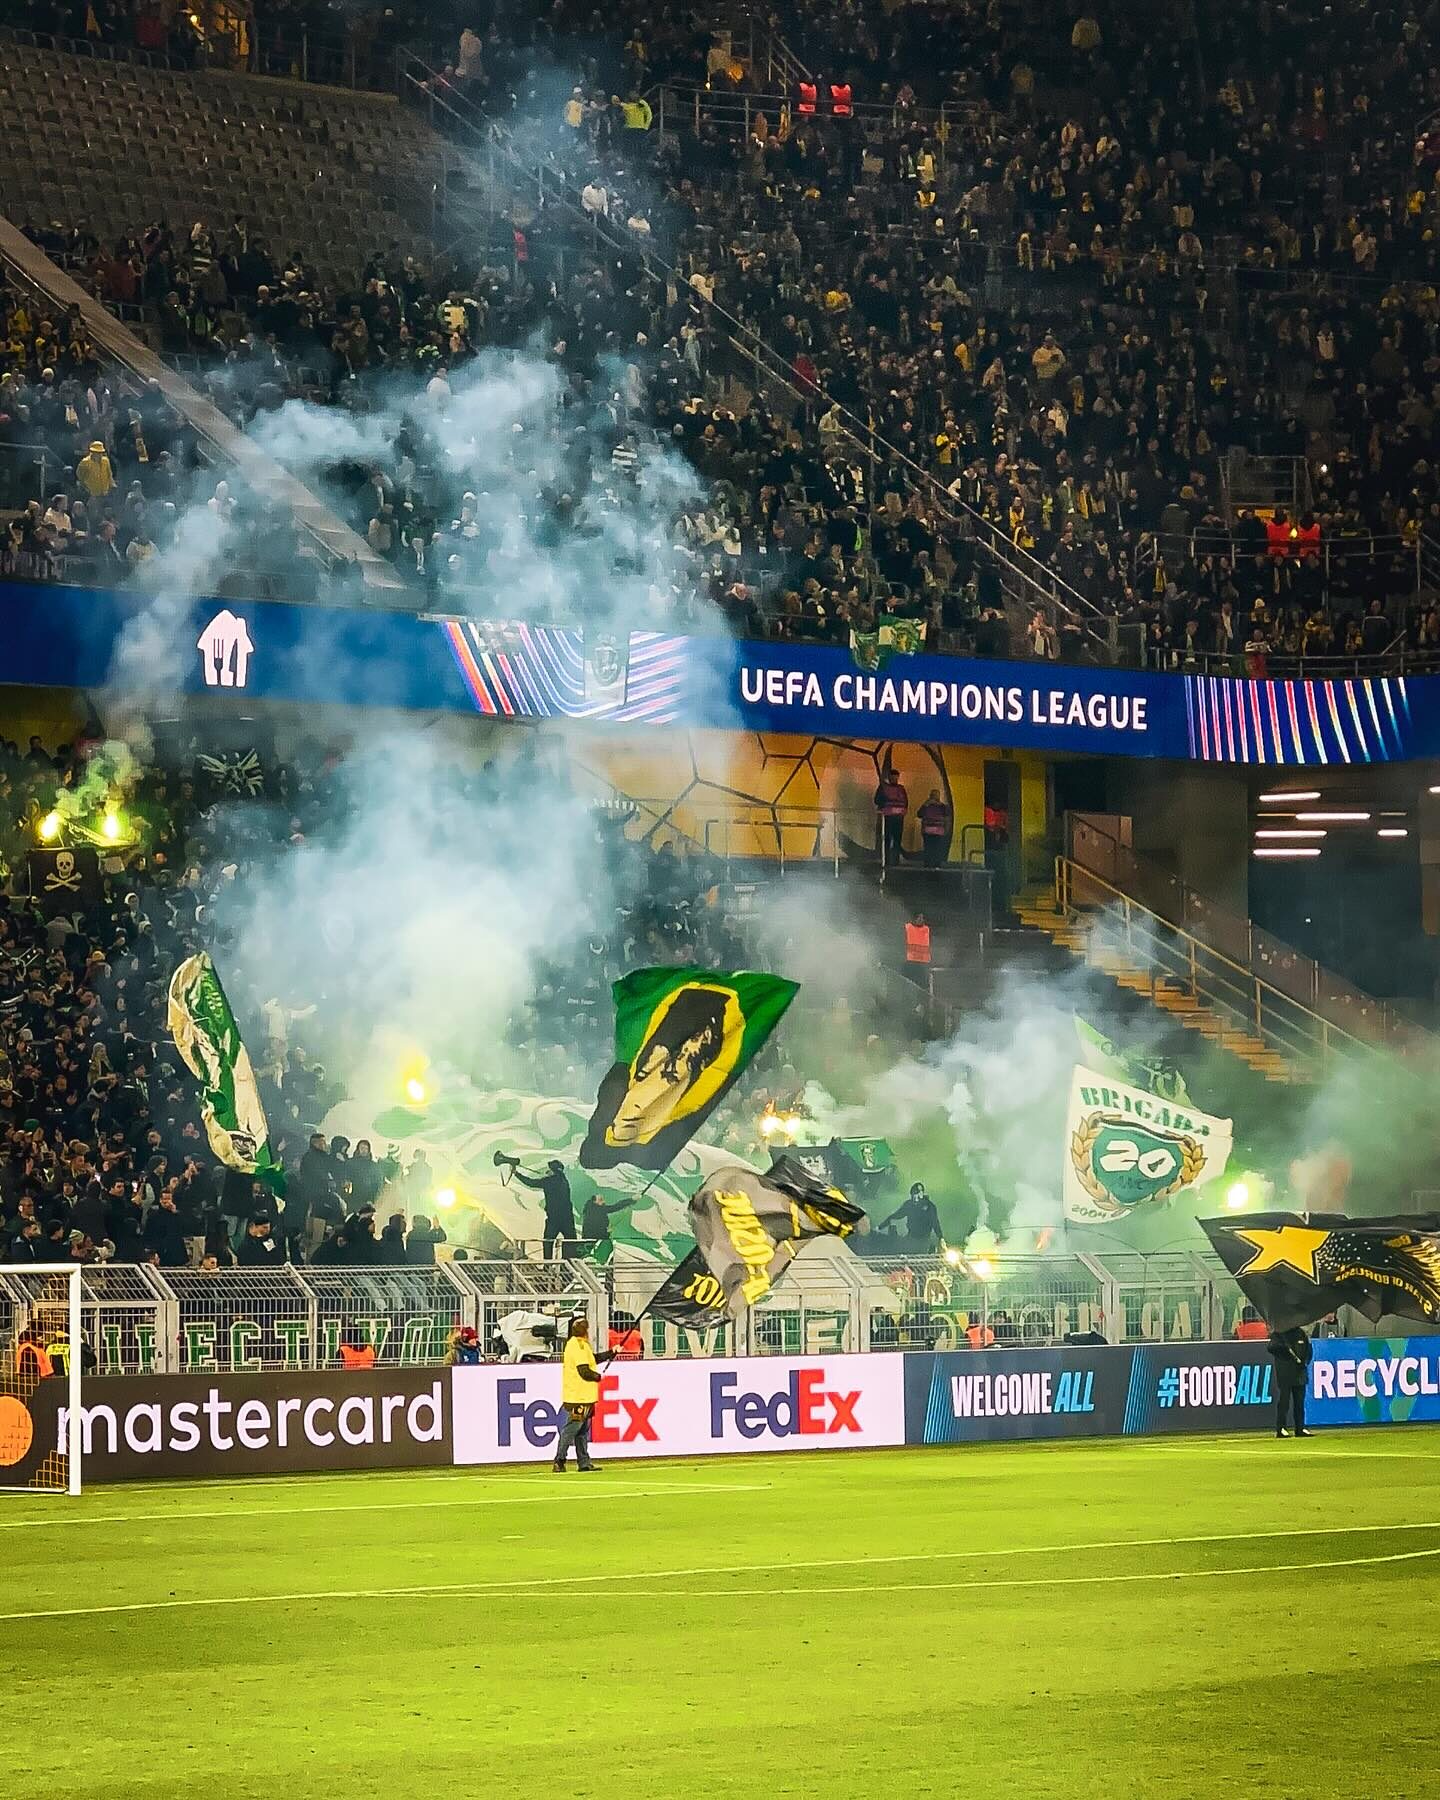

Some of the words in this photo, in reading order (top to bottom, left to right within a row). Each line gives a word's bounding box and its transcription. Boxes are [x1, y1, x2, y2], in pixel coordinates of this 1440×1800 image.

[741, 667, 824, 707] UEFA
[833, 674, 1024, 722] CHAMPIONS
[1032, 689, 1148, 730] LEAGUE
[1100, 1139, 1177, 1179] 20
[1071, 1204, 1108, 1218] 2004
[951, 1373, 1052, 1418] WELCOME
[1054, 1371, 1096, 1414] ALL
[1157, 1364, 1273, 1409] #FOOTBALL
[1313, 1356, 1440, 1398] RECYCL
[57, 1381, 444, 1455] mastercard
[497, 1375, 660, 1448] FeEx
[710, 1368, 863, 1438] FedEx
